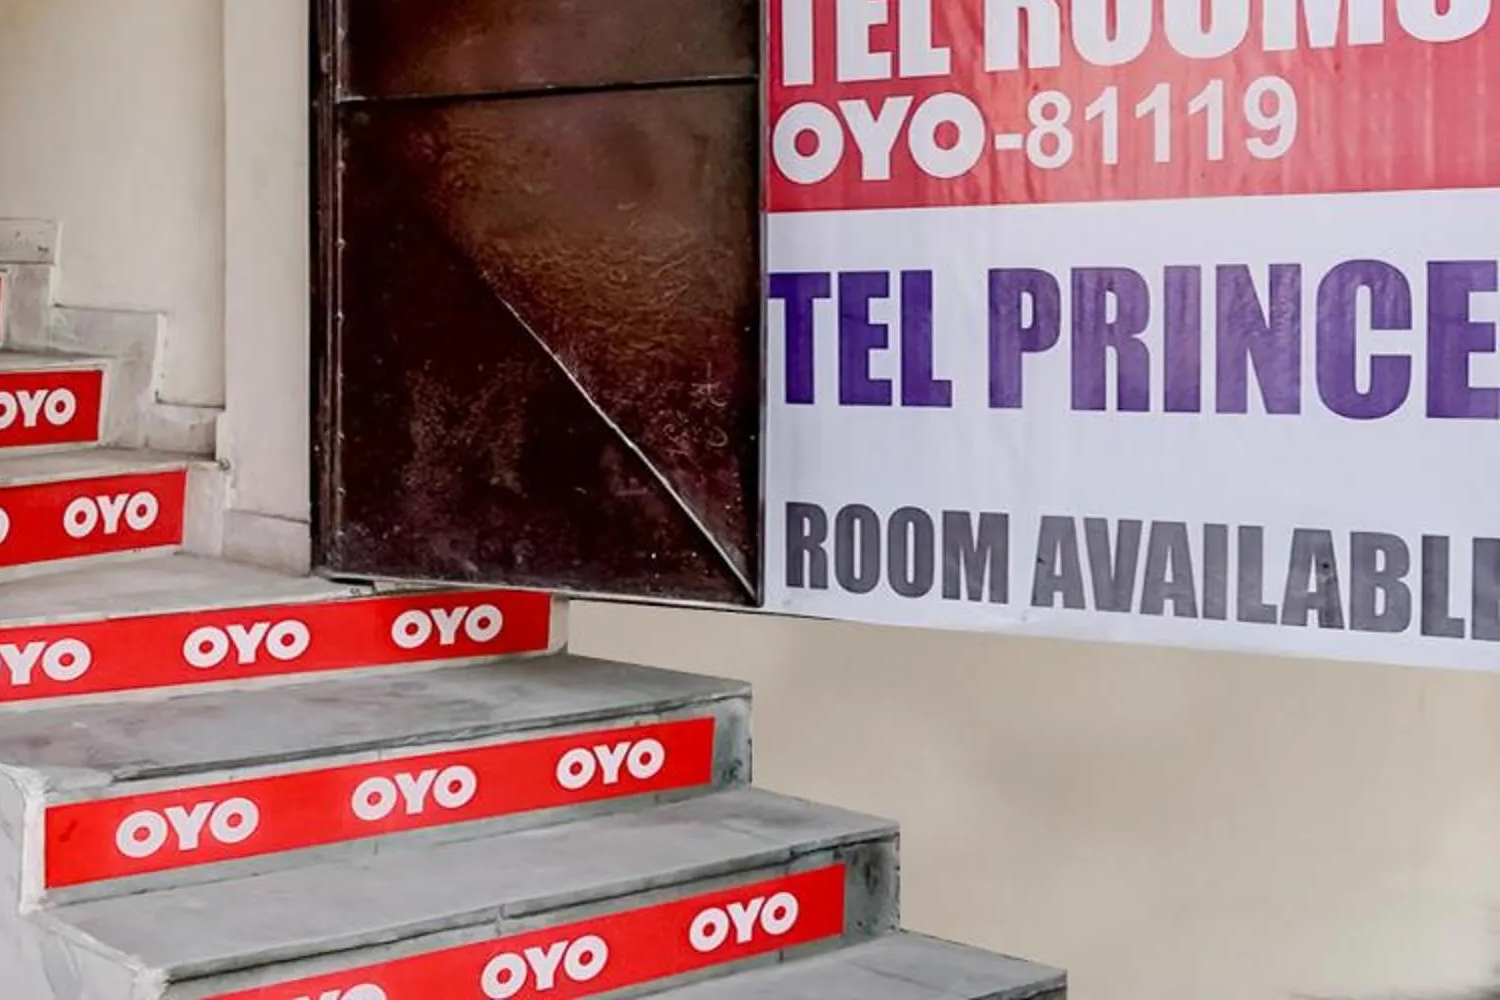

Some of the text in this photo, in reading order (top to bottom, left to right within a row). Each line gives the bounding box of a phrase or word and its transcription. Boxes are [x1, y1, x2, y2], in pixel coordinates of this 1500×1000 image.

[772, 75, 1299, 184] OYO-81119
[767, 258, 1500, 421] TEL PRINCE
[62, 491, 159, 538] OYO
[784, 501, 1010, 605] ROOM
[183, 619, 310, 668] OYO
[390, 604, 503, 649] OYO
[114, 738, 666, 859] OYO OYO OYO
[480, 890, 799, 1000] OYO OYO
